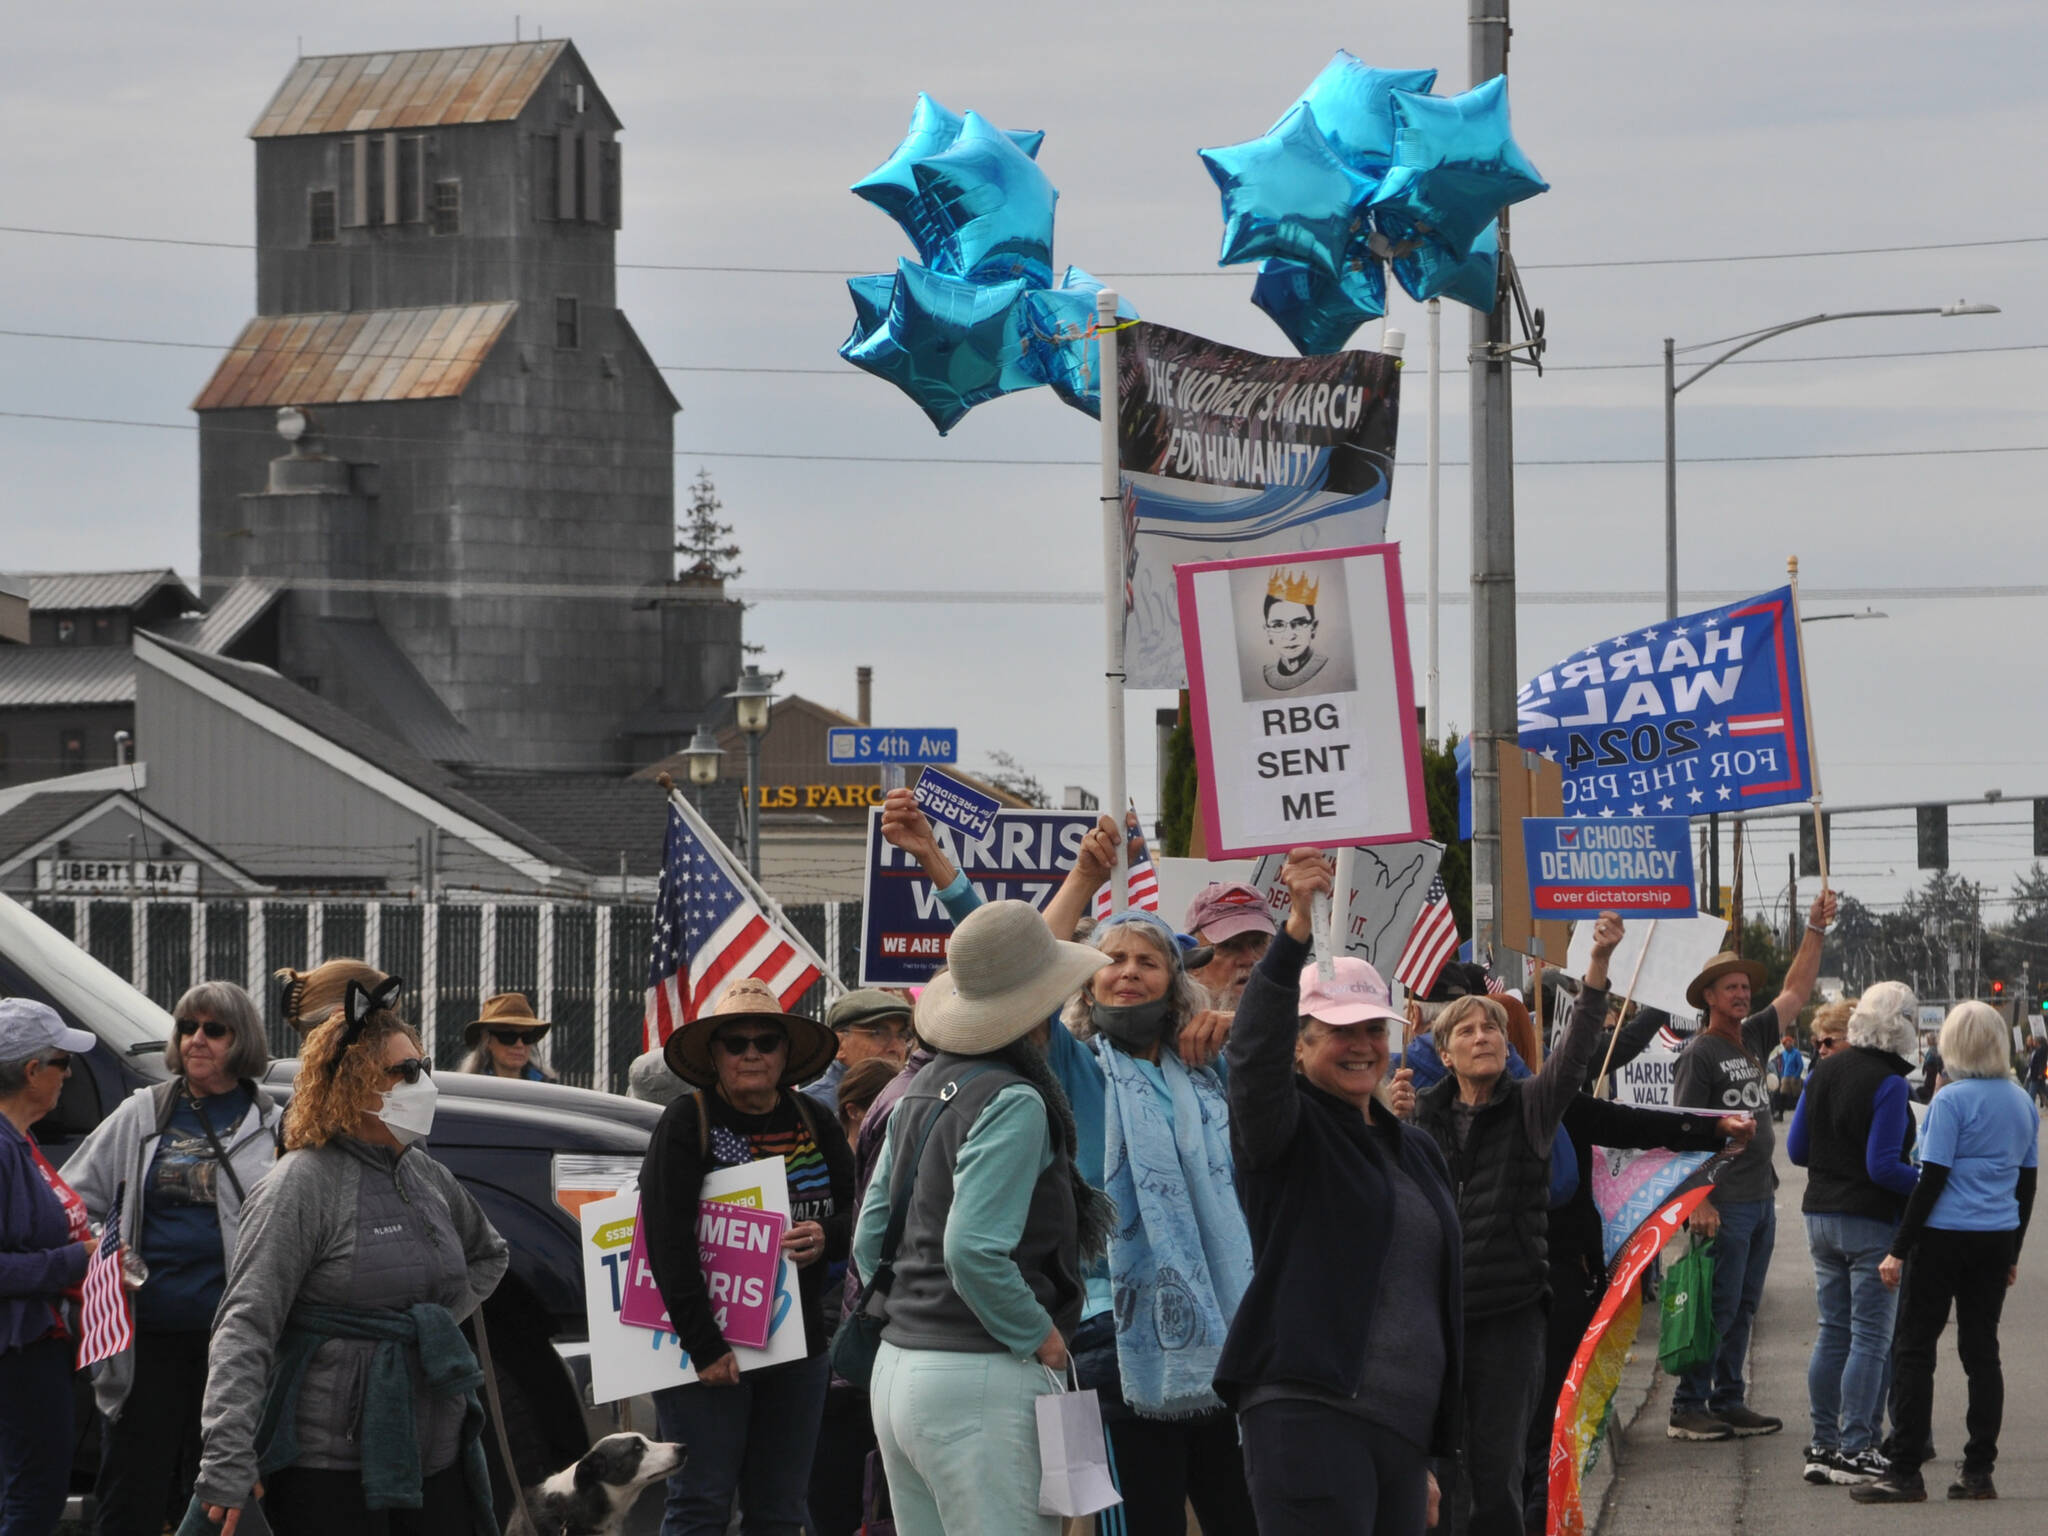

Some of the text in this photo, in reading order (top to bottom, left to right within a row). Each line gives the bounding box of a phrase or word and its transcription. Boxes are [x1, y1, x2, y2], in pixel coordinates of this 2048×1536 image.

[1147, 358, 1364, 429] THE WOMEN'S MARCH
[1161, 428, 1321, 486] FOR HUMANITY
[1262, 703, 1339, 736] RBG
[860, 735, 951, 757] S 4th Ave
[1257, 744, 1351, 778] SENT
[743, 785, 798, 807] LS
[919, 779, 979, 812] PRESIDENT
[1282, 790, 1337, 821] ME
[914, 787, 988, 834] HARRIS
[1583, 825, 1657, 849] CHOOSE
[57, 863, 183, 881] IBERT BAY
[1540, 851, 1677, 880] DEMOCRACY
[1553, 889, 1672, 905] over dictatorship
[883, 937, 906, 953] WE
[910, 937, 940, 953] ARE
[1624, 1062, 1675, 1084] HARRIS
[1720, 1057, 1748, 1073] KNOW
[1633, 1086, 1669, 1104] WALZ
[698, 1214, 771, 1254] MEN
[635, 1258, 764, 1308] HRIS
